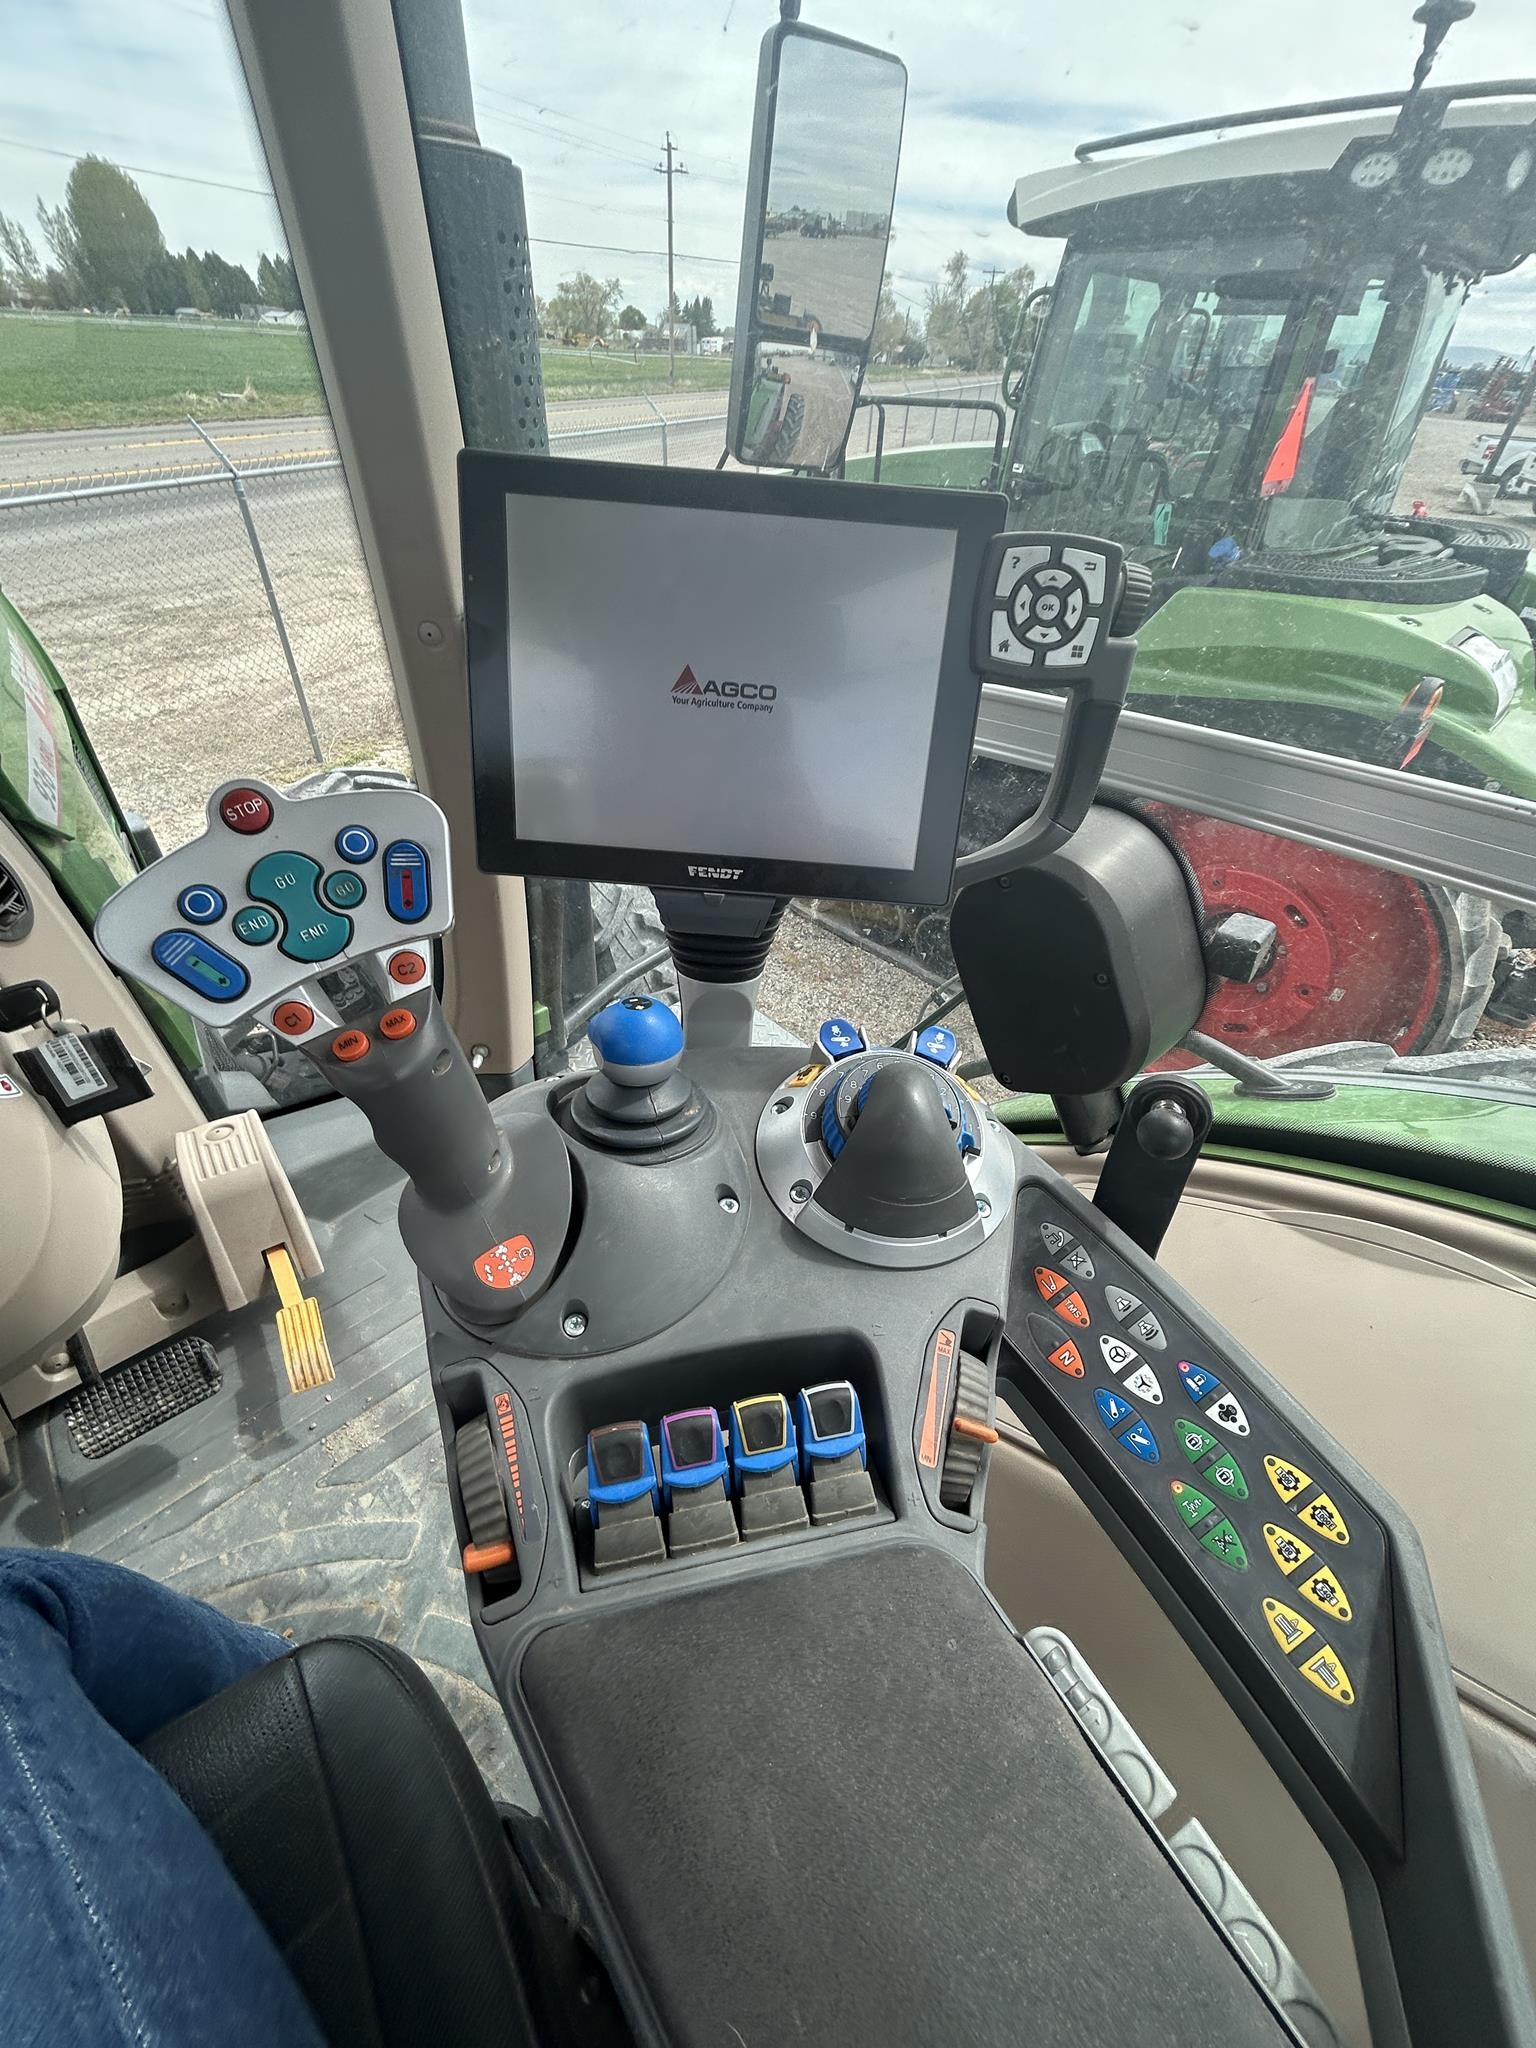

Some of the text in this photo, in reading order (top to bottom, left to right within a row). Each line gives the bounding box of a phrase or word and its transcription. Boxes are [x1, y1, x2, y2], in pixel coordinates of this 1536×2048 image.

[1041, 603, 1055, 612] OK
[703, 680, 777, 701] AGCO
[672, 695, 774, 713] Your Agriculture Company
[226, 798, 263, 821] STOP
[687, 865, 744, 880] FENDT
[274, 872, 296, 889] GO
[335, 880, 355, 896] GO
[238, 915, 269, 936] END
[300, 922, 329, 942] END
[396, 961, 418, 976] C2
[284, 1012, 302, 1028] C1
[385, 1014, 407, 1029] MAX
[338, 1034, 360, 1051] MIN
[875, 1061, 884, 1070] 6
[861, 1069, 869, 1078] 7
[850, 1080, 858, 1089] 8
[939, 1087, 947, 1096] 2
[819, 1088, 827, 1097] 8
[844, 1095, 852, 1104] 9
[810, 1111, 818, 1120] 9
[1064, 1299, 1082, 1319] TMS
[938, 1345, 952, 1355] MAX
[1059, 1350, 1075, 1367] N
[1279, 1470, 1293, 1485] 1000
